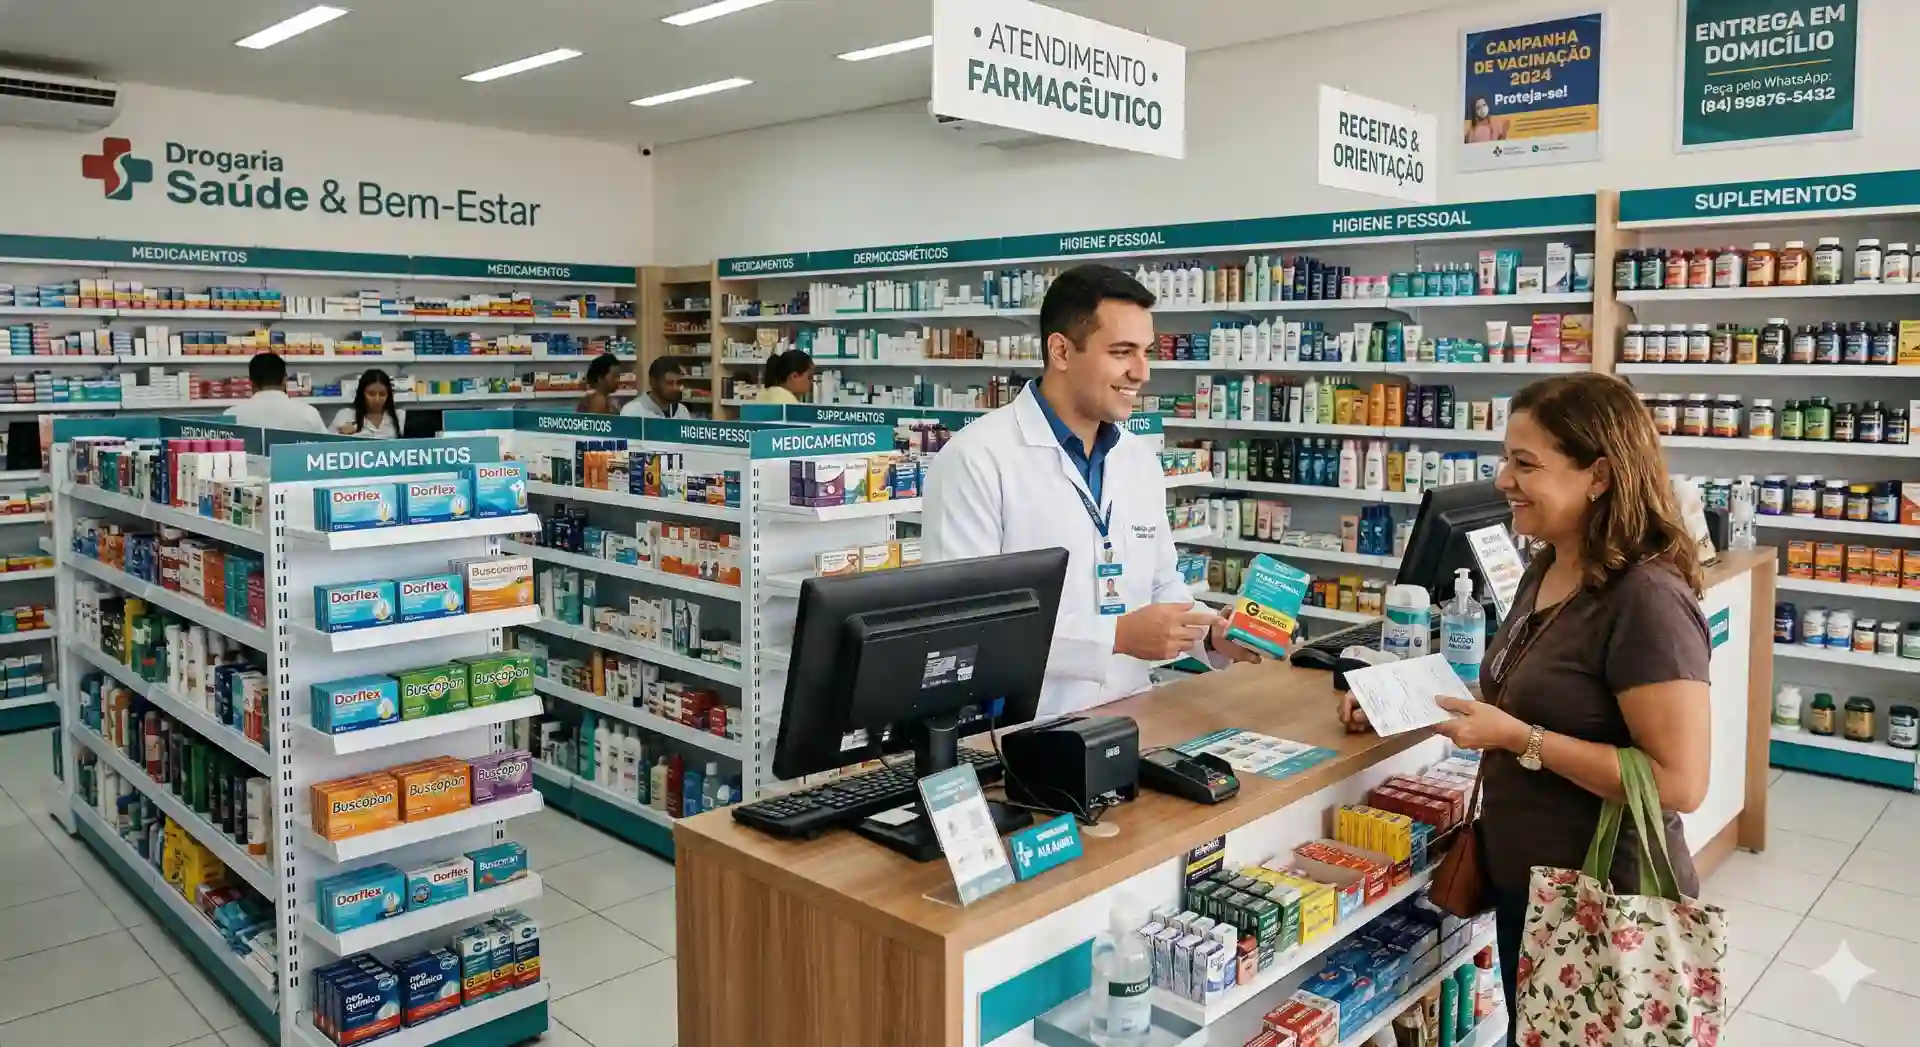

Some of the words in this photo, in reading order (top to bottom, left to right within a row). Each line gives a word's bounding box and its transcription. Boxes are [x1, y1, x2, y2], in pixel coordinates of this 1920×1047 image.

[1696, 10, 1804, 42] ENTREGA
[1810, 4, 1846, 26] EM
[1486, 30, 1579, 56] CAMPANHA
[1705, 30, 1834, 64] DOMICÍLIO
[988, 22, 1146, 87] ATENDIMENTO
[1474, 60, 1494, 74] DE
[1496, 46, 1591, 70] VACINAÇÃO
[1510, 68, 1552, 86] 2024
[1704, 84, 1733, 96] Peça
[1736, 79, 1762, 94] pelo
[1764, 72, 1832, 88] WhatsApp:
[968, 58, 1162, 130] FARMACÊUTICO
[1494, 85, 1568, 106] Proteja-se!
[1701, 97, 1731, 116] (84)
[1735, 87, 1836, 110] 99876-5432
[1339, 111, 1408, 150] RECEITAS
[1410, 130, 1420, 152] &
[166, 142, 284, 173] Drogaria
[1334, 143, 1424, 186] ORIENTAÇÃO
[166, 169, 308, 212] Saúde
[320, 179, 347, 214] &
[358, 181, 541, 226] Bem-Estar
[1695, 183, 1857, 210] SUPLEMENTOS
[1332, 216, 1393, 233] HIGIENE
[1396, 210, 1472, 229] PESSOAL
[1060, 236, 1106, 251] HIGIENE
[1109, 232, 1166, 248] PESSOAL
[132, 246, 248, 264] MEDICAMENTOS
[732, 258, 794, 272] MEDICAMENTOS
[853, 246, 949, 264] DERMOCOSMÉTICOS
[487, 264, 570, 278] MEDICAMENTOS
[538, 416, 612, 432] DERMOCOSMÉTICOS
[680, 425, 718, 441] HIGIENE
[720, 428, 752, 444] PESSO
[772, 432, 876, 452] MEDICAMENTOS
[306, 446, 471, 472] MEDICAMENTOS
[333, 491, 380, 503] Dorflex
[410, 484, 456, 496] Dorflex
[331, 589, 380, 604] Dorflex
[403, 580, 448, 594] Dorflex
[406, 676, 464, 697] Buscopan
[474, 666, 530, 686] Buscopan
[335, 689, 381, 705] Dorflex
[478, 761, 527, 780] Buscopan
[409, 776, 465, 796] Buscopan
[332, 792, 392, 814] Buscopan
